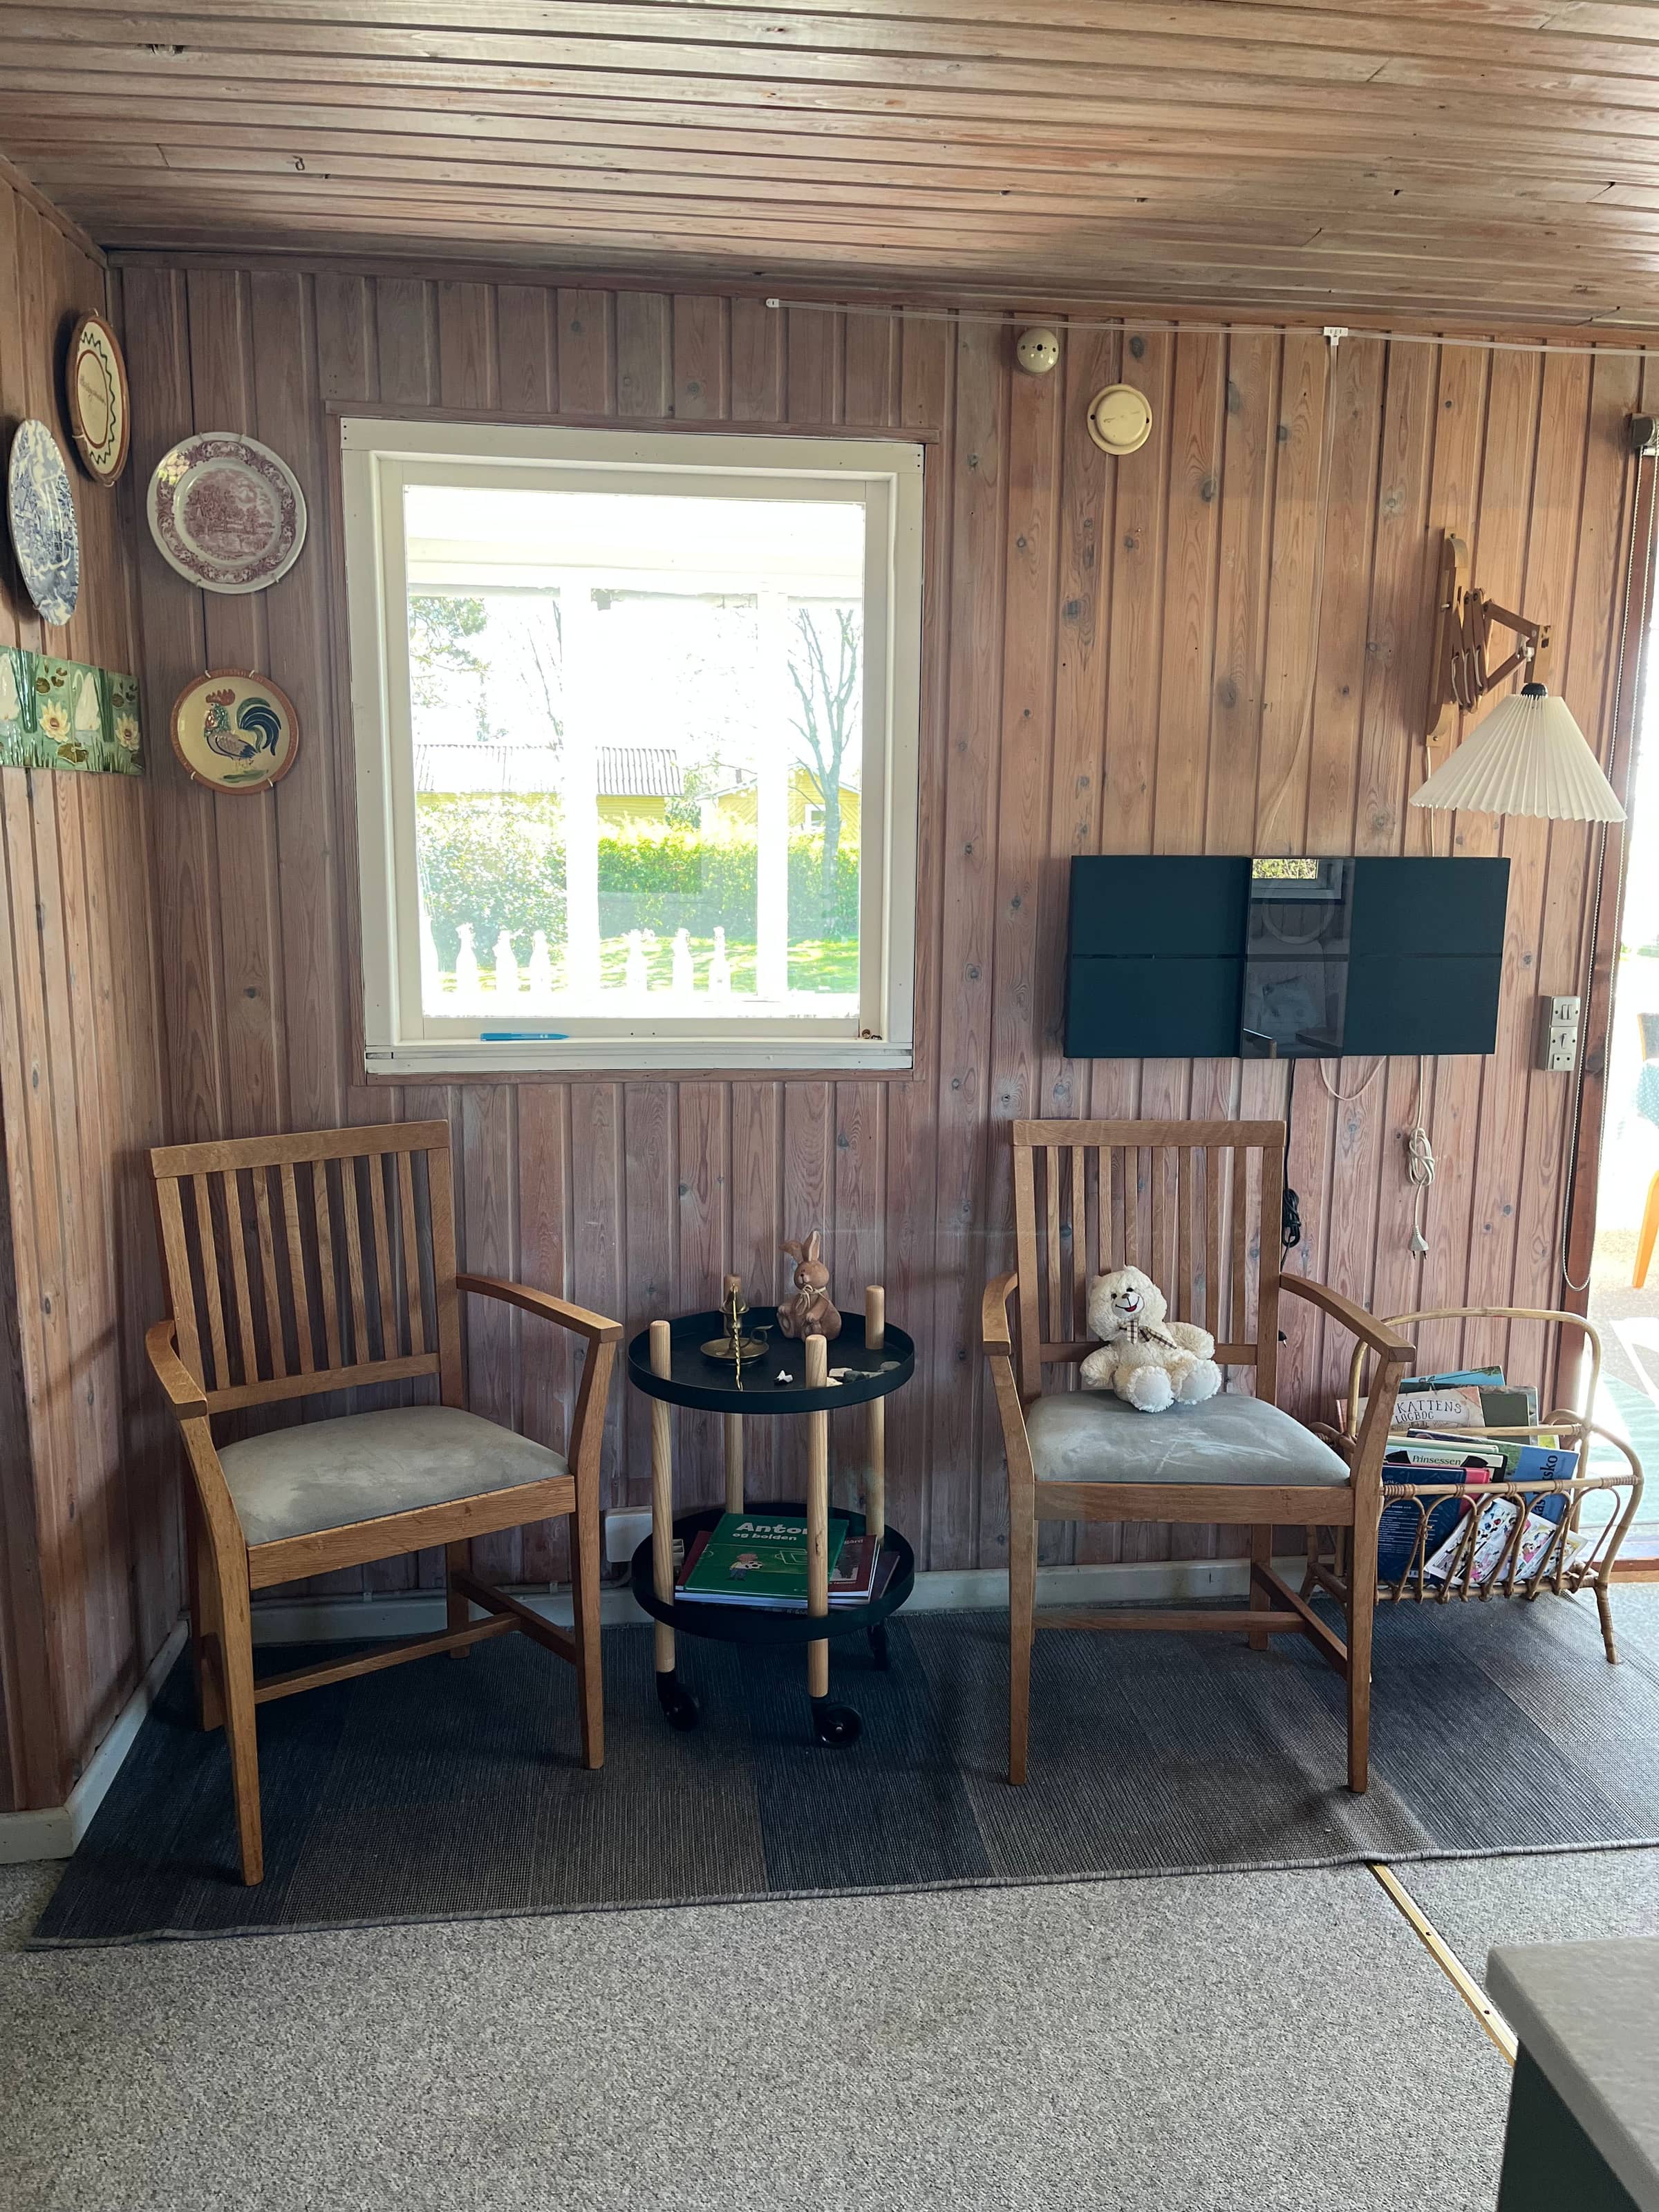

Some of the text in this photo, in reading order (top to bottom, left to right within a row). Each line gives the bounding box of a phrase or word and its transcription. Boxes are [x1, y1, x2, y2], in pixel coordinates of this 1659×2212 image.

[1396, 1400, 1462, 1414] KATTENS
[1395, 1411, 1434, 1424] LOGBOG
[1412, 1454, 1462, 1465] Prinsessen
[751, 1533, 797, 1541] bolden
